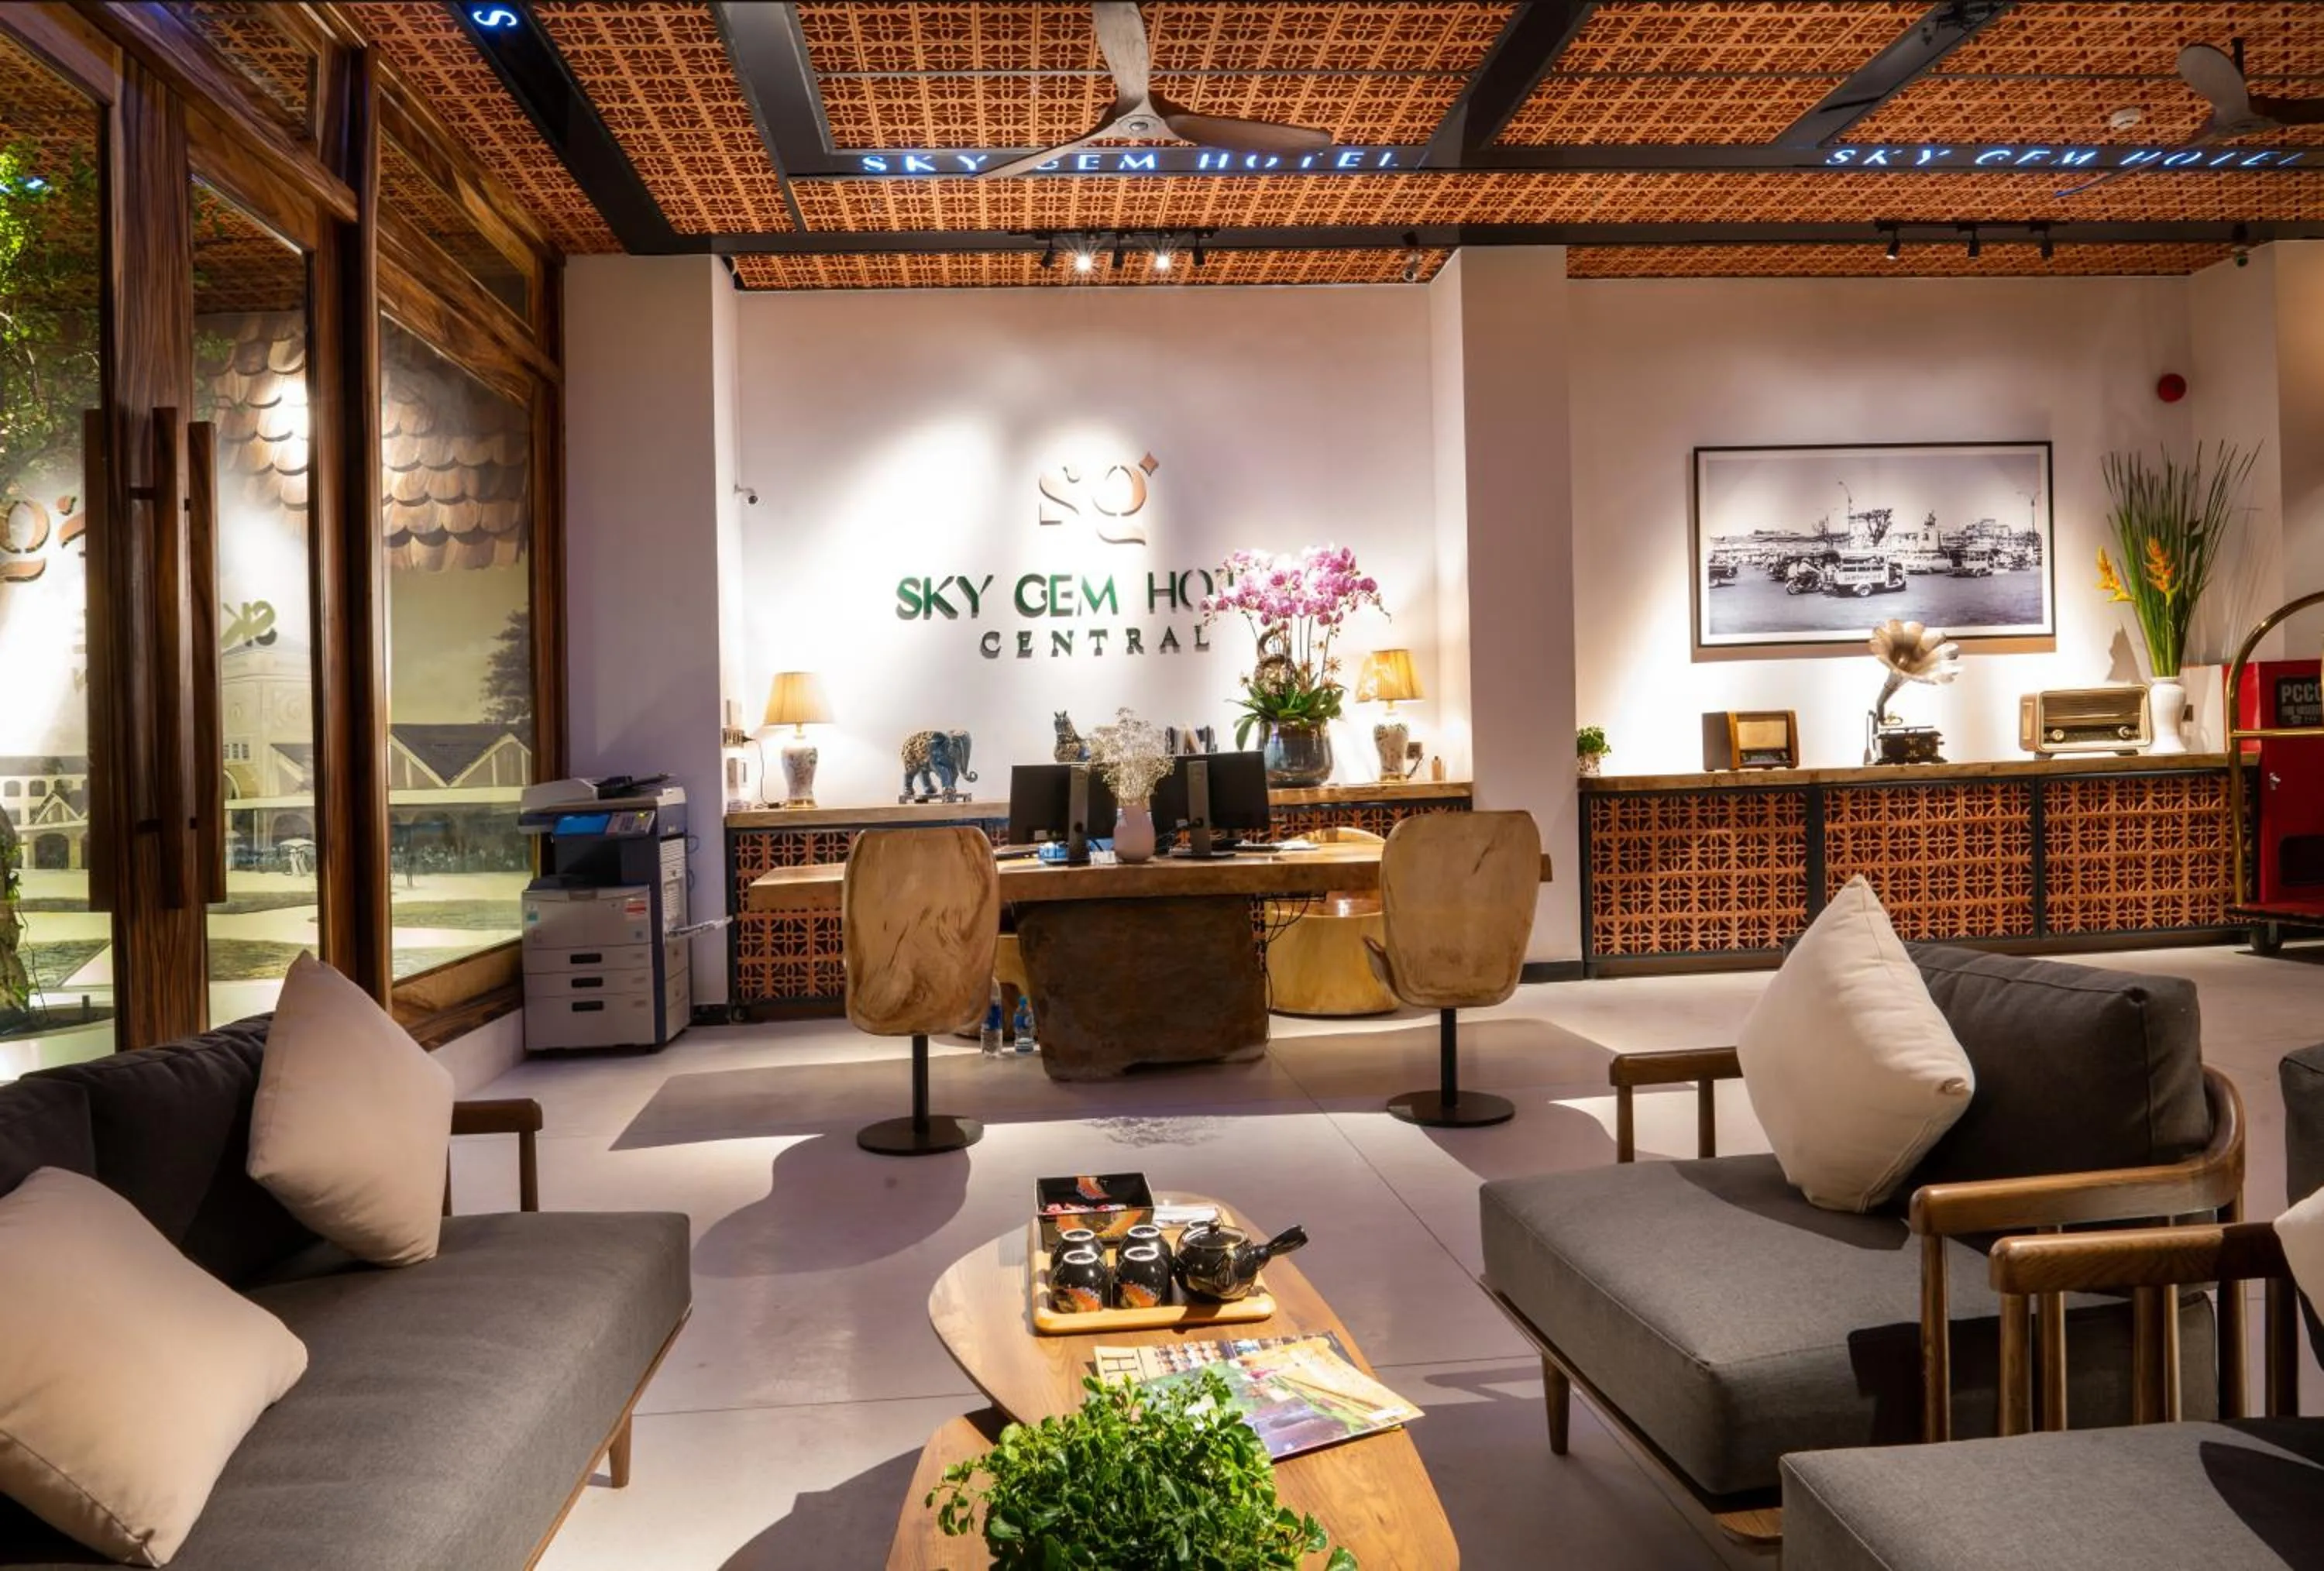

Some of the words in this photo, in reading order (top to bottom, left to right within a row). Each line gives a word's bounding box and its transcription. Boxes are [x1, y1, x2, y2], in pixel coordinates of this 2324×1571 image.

[862, 155, 988, 171] SKY
[896, 574, 994, 620] SKY
[1014, 572, 1119, 618] GEM
[1147, 568, 1245, 614] HOT
[980, 625, 1211, 658] CENTRAL
